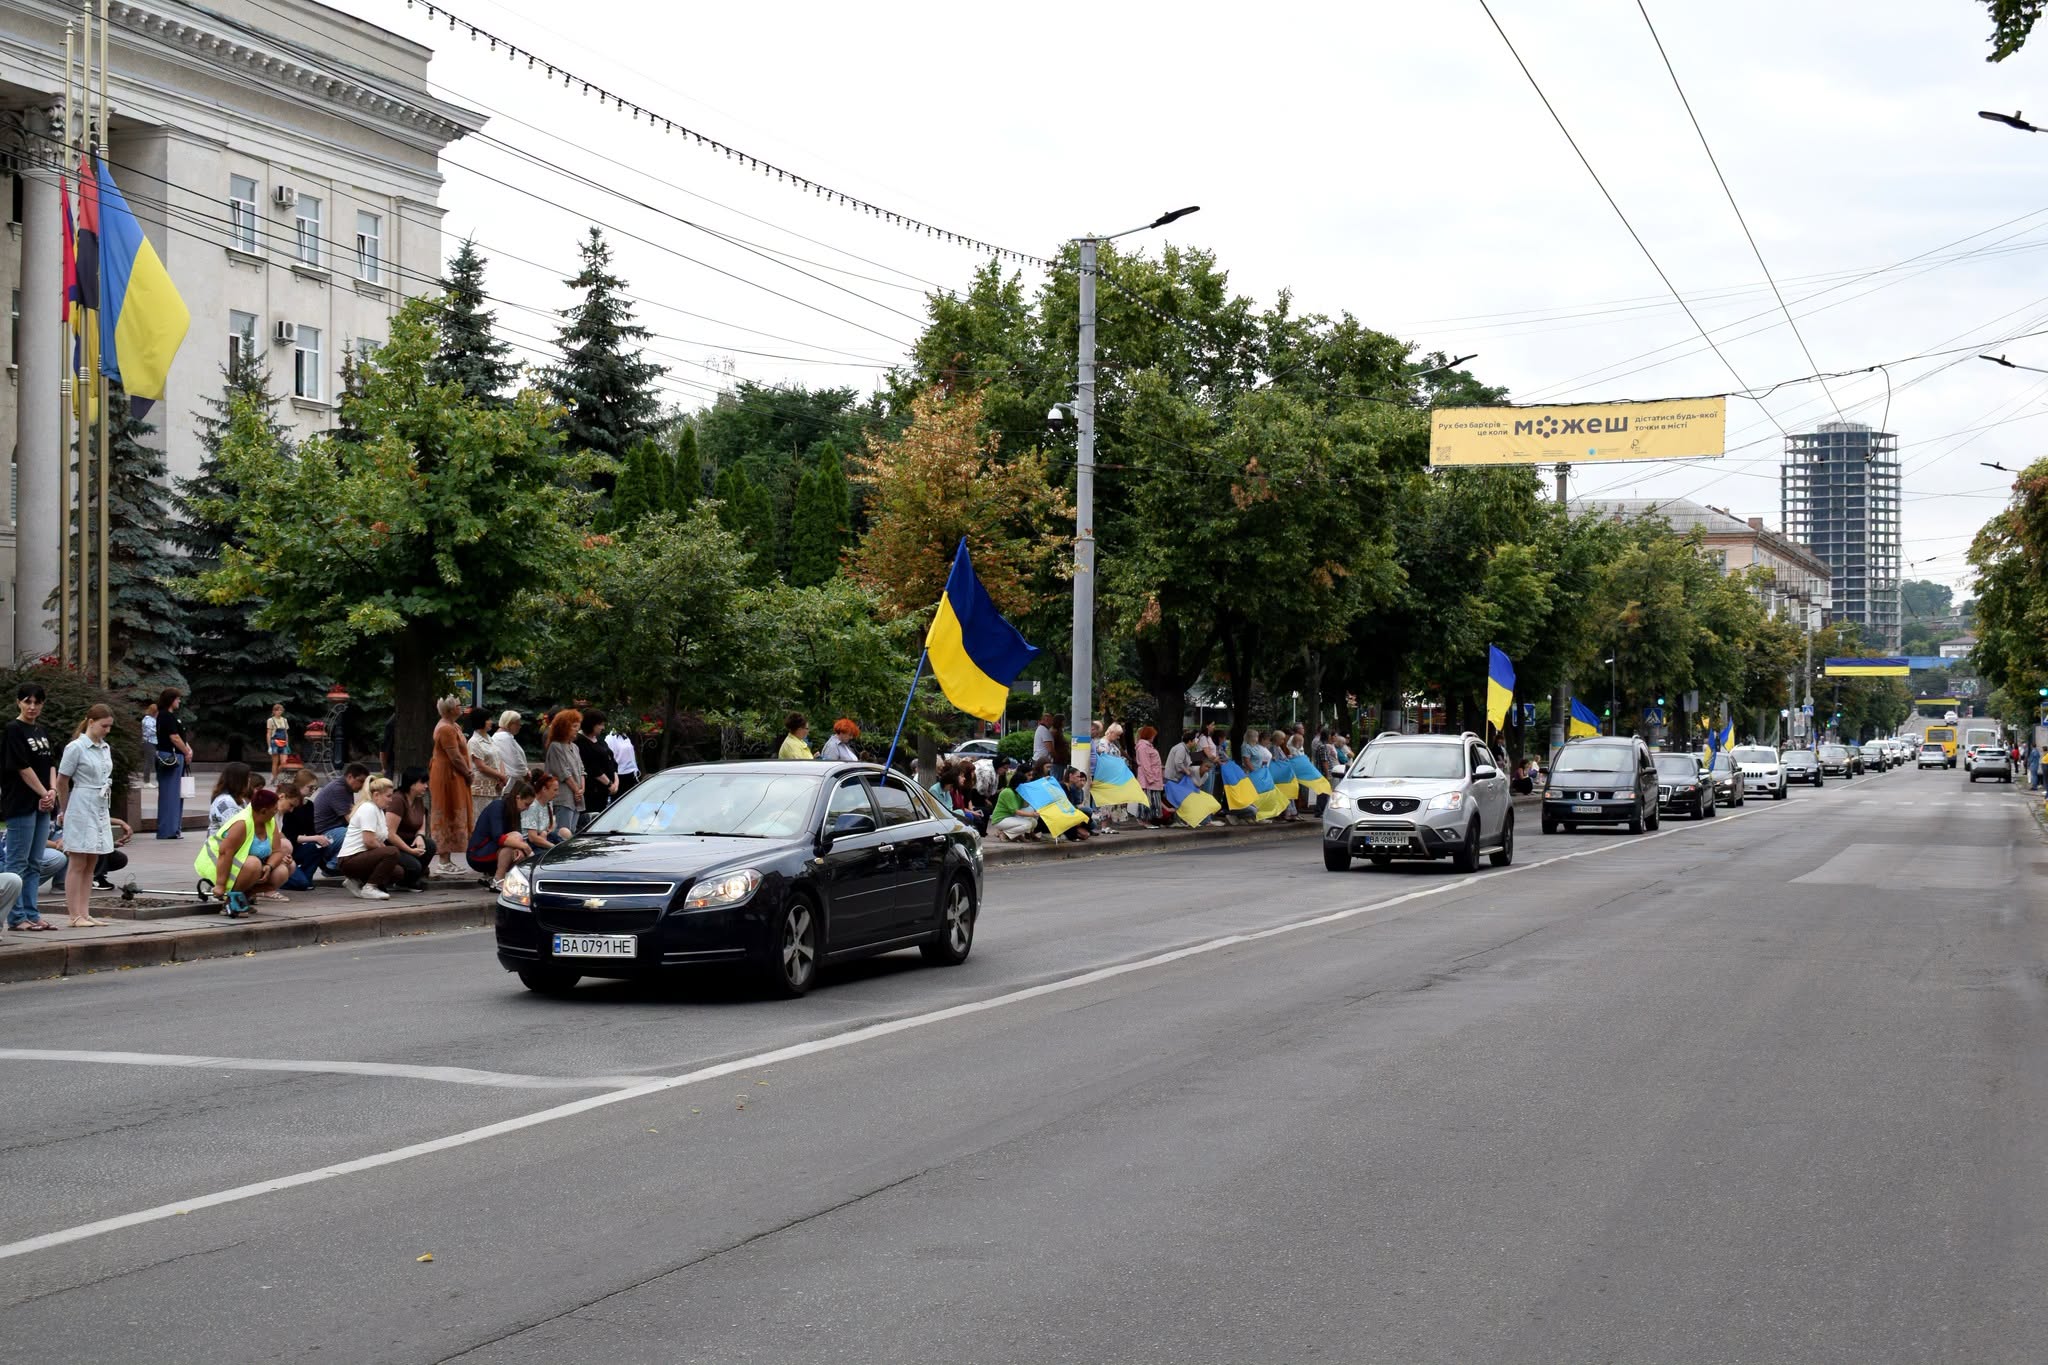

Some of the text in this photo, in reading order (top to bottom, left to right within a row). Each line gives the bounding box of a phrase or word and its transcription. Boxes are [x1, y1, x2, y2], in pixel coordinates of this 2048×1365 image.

[1634, 410, 1718, 423] дістатися будь-якої
[1438, 423, 1453, 431] Рух
[1667, 421, 1688, 430] місті
[1380, 836, 1397, 844] 4083
[562, 939, 632, 953] BA 0791 HE
